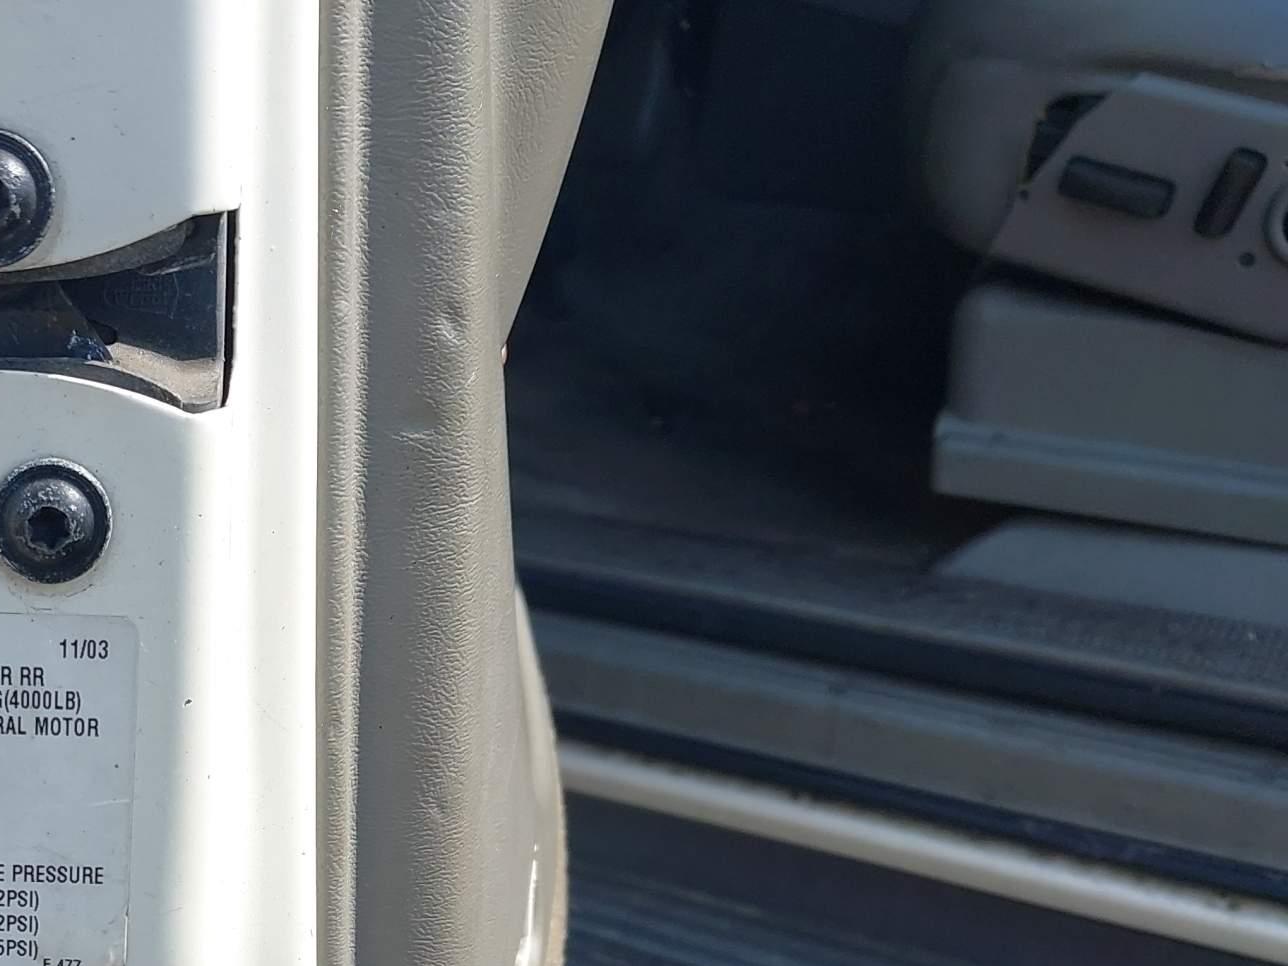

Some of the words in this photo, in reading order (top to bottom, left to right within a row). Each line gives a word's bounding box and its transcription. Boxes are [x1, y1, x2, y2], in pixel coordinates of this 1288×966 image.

[59, 639, 109, 660] 11/03
[20, 666, 45, 687] RR
[34, 717, 100, 737] MOTOR
[12, 864, 104, 885] PRESSURE
